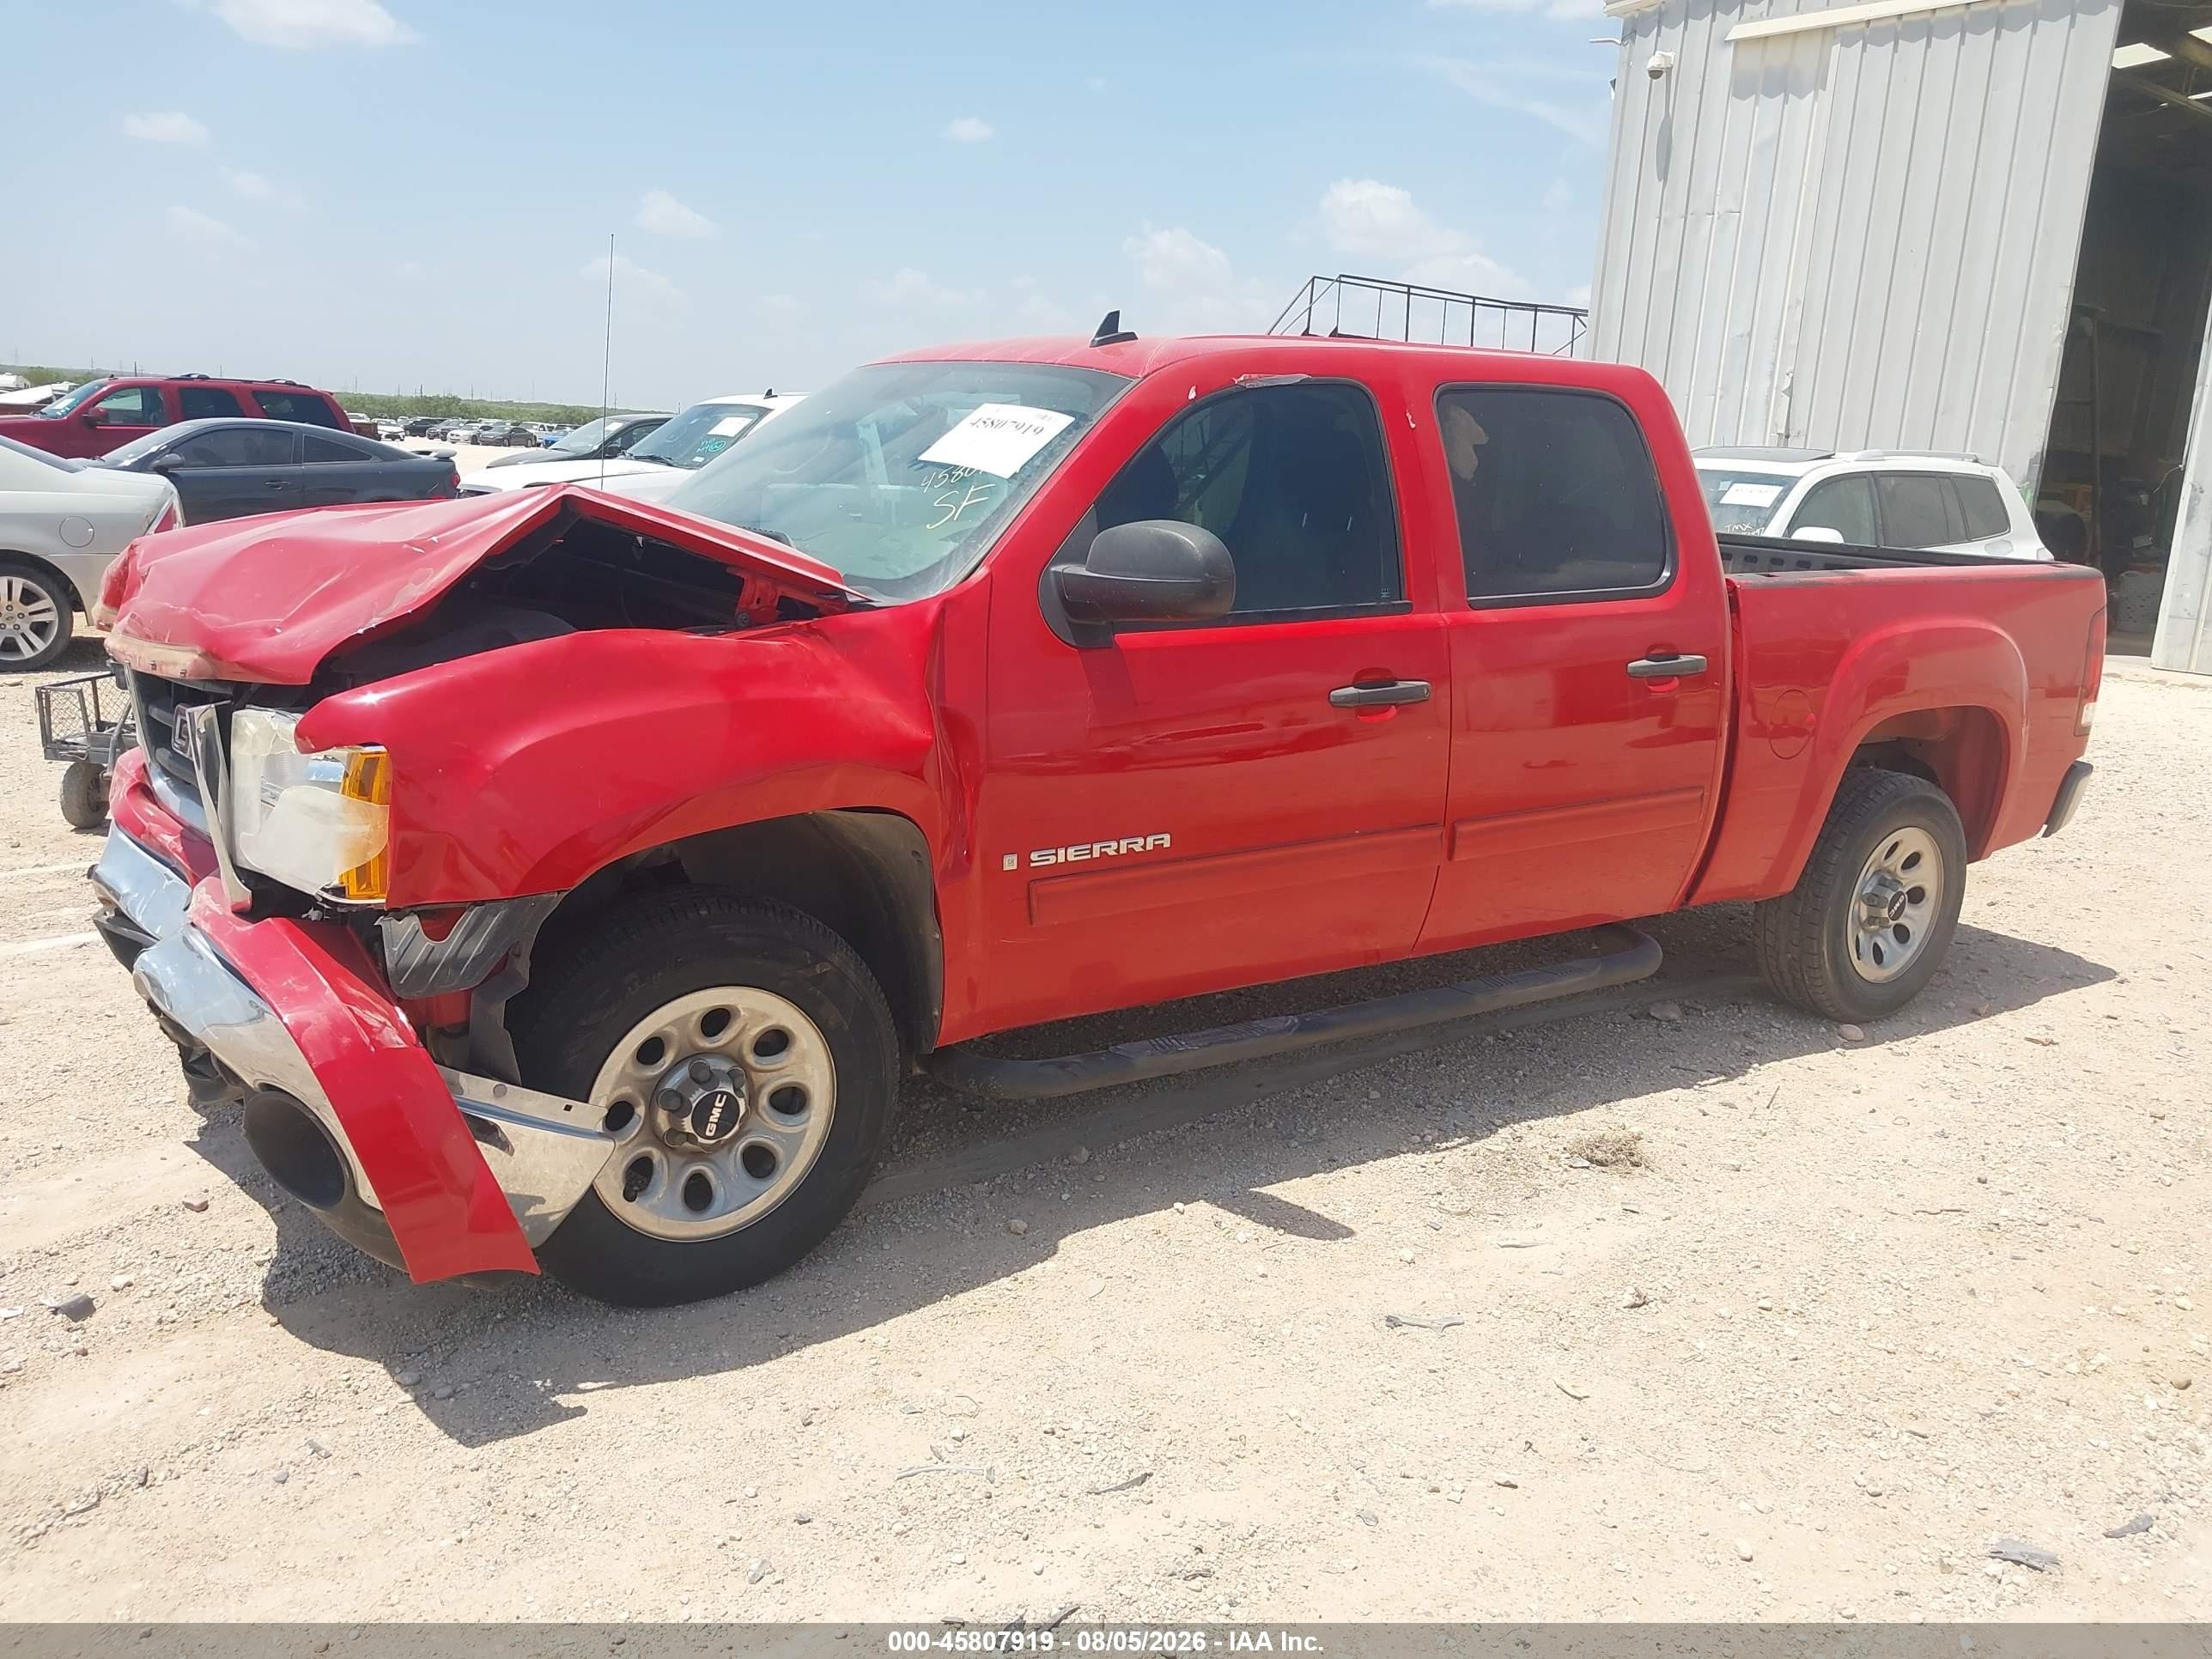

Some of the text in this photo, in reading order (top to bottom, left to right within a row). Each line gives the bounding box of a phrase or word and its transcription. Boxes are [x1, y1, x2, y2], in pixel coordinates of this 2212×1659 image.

[927, 483, 996, 529] SF
[1030, 832, 1171, 867] SIERRA
[1889, 895, 1905, 918] GMC
[705, 1093, 727, 1137] GMC
